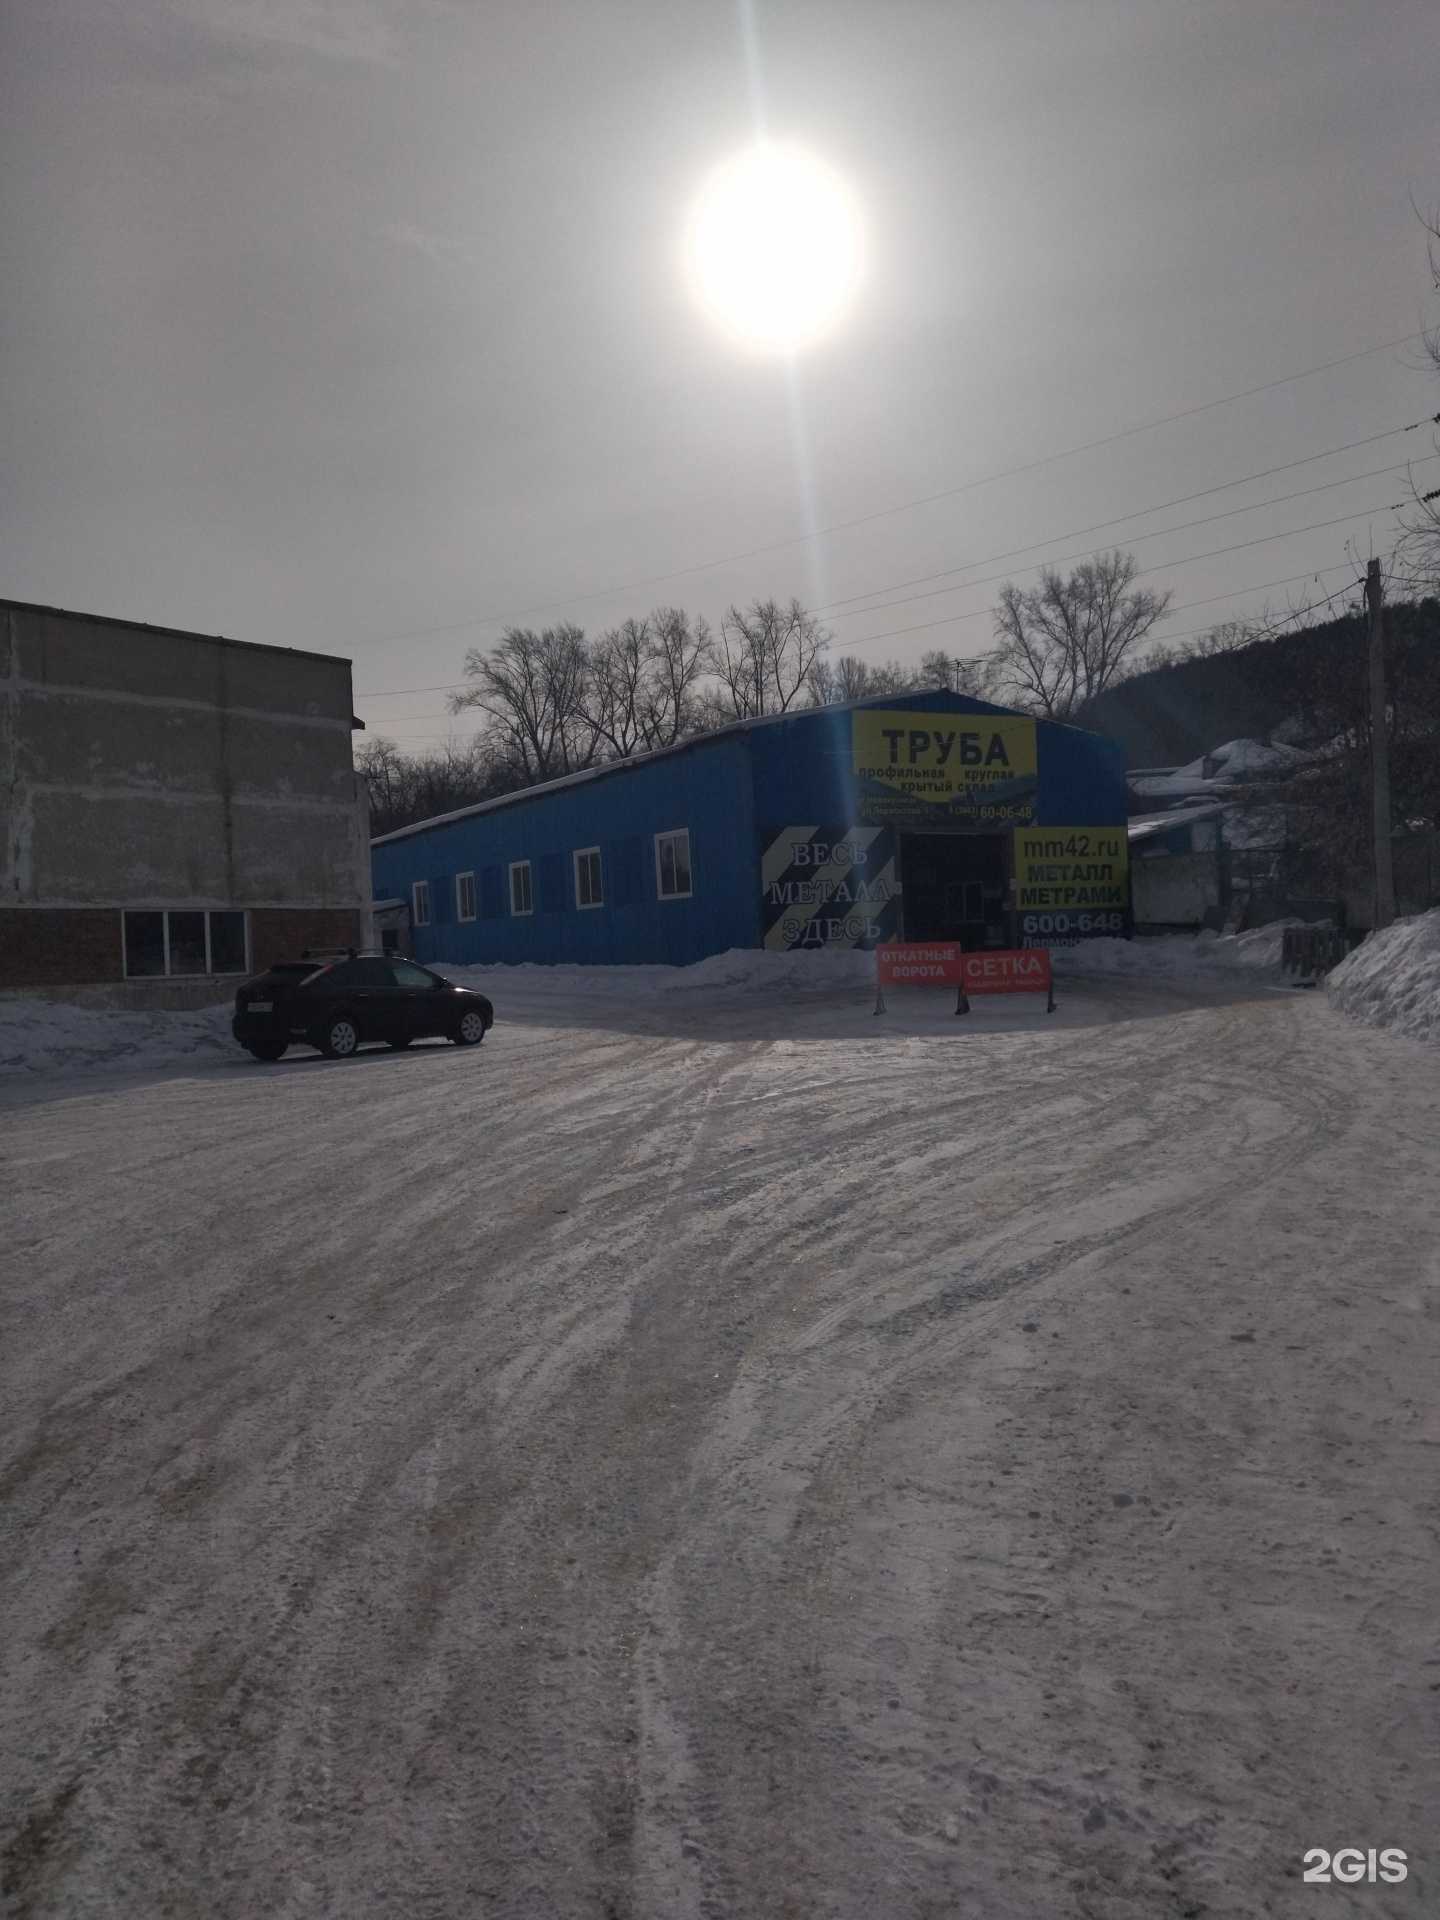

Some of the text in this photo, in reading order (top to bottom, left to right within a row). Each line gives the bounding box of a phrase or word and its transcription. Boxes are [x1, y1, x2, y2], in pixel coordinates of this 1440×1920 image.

[882, 729, 1009, 766] ТРУБА
[859, 766, 1015, 782] профильная круглая
[901, 780, 995, 795] крытый склад
[790, 841, 868, 866] ВЕСЬ
[1024, 835, 1120, 858] mm42.ru
[1027, 864, 1113, 882] МЕТАЛЛ
[769, 880, 891, 904] МЕТАЛЛ
[1021, 887, 1122, 905] МЕТРАМИ
[783, 916, 882, 944] ЗДЕСЬ
[1023, 913, 1123, 933] 600-648
[881, 949, 956, 962] ОТКАТНЫЕ
[893, 965, 946, 977] ВОРОТА
[966, 957, 1042, 977] СЕТКА
